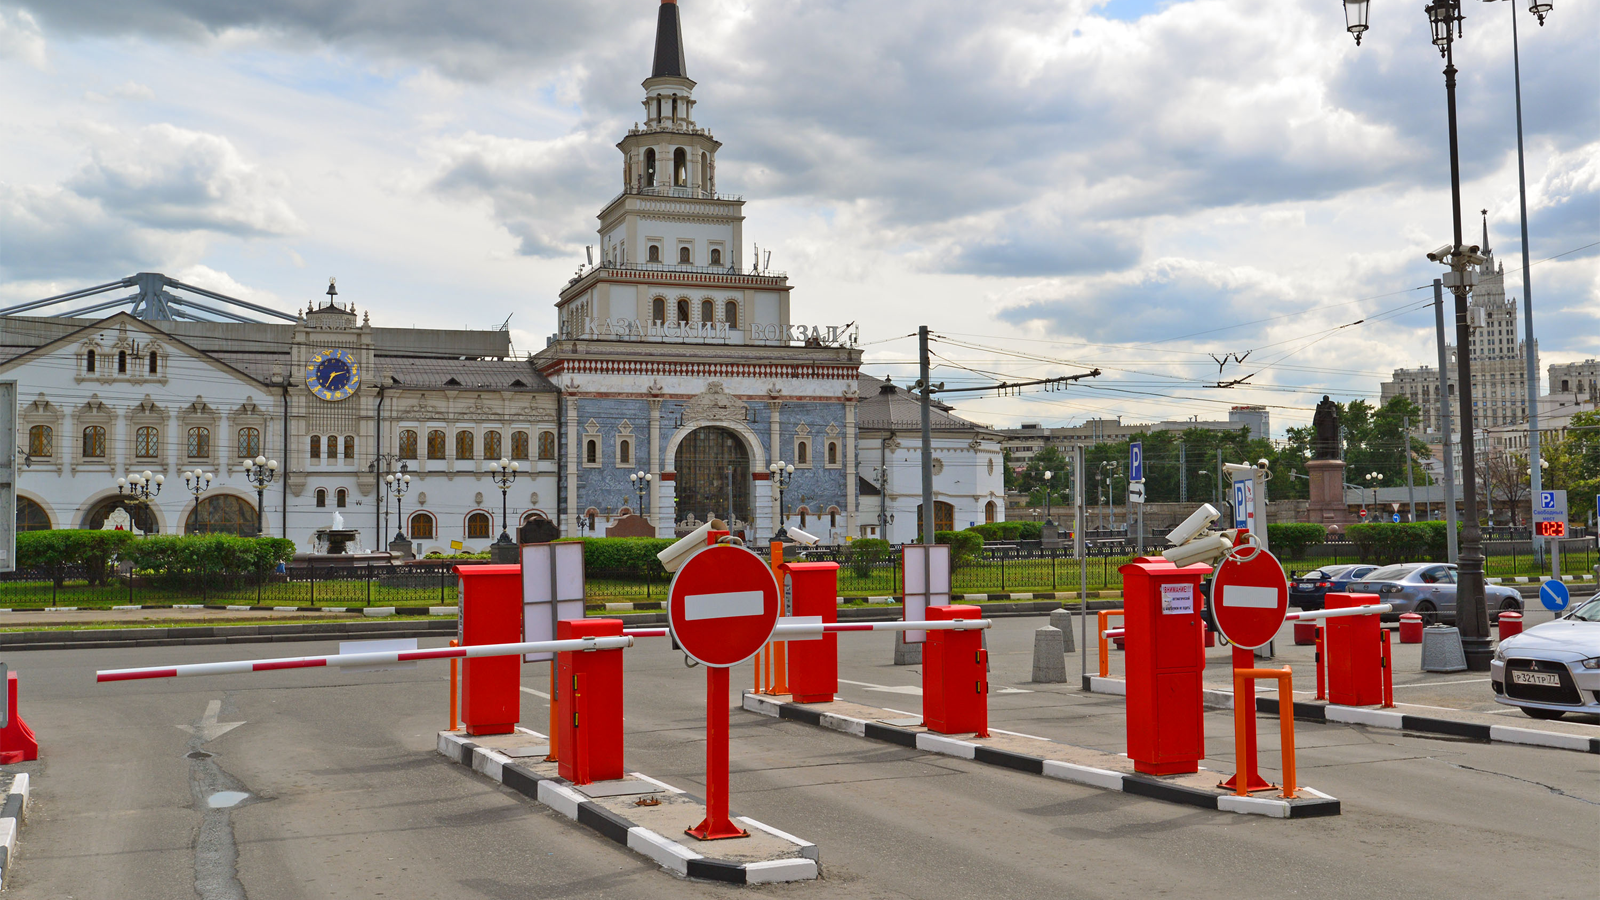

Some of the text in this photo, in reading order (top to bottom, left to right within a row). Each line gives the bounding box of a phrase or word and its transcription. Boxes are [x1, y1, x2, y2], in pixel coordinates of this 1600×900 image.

[584, 316, 839, 343] КАЗАНСКИЙ ВОКЗАЛ
[1132, 447, 1140, 477] P
[1236, 486, 1243, 517] P
[1542, 521, 1565, 536] 023
